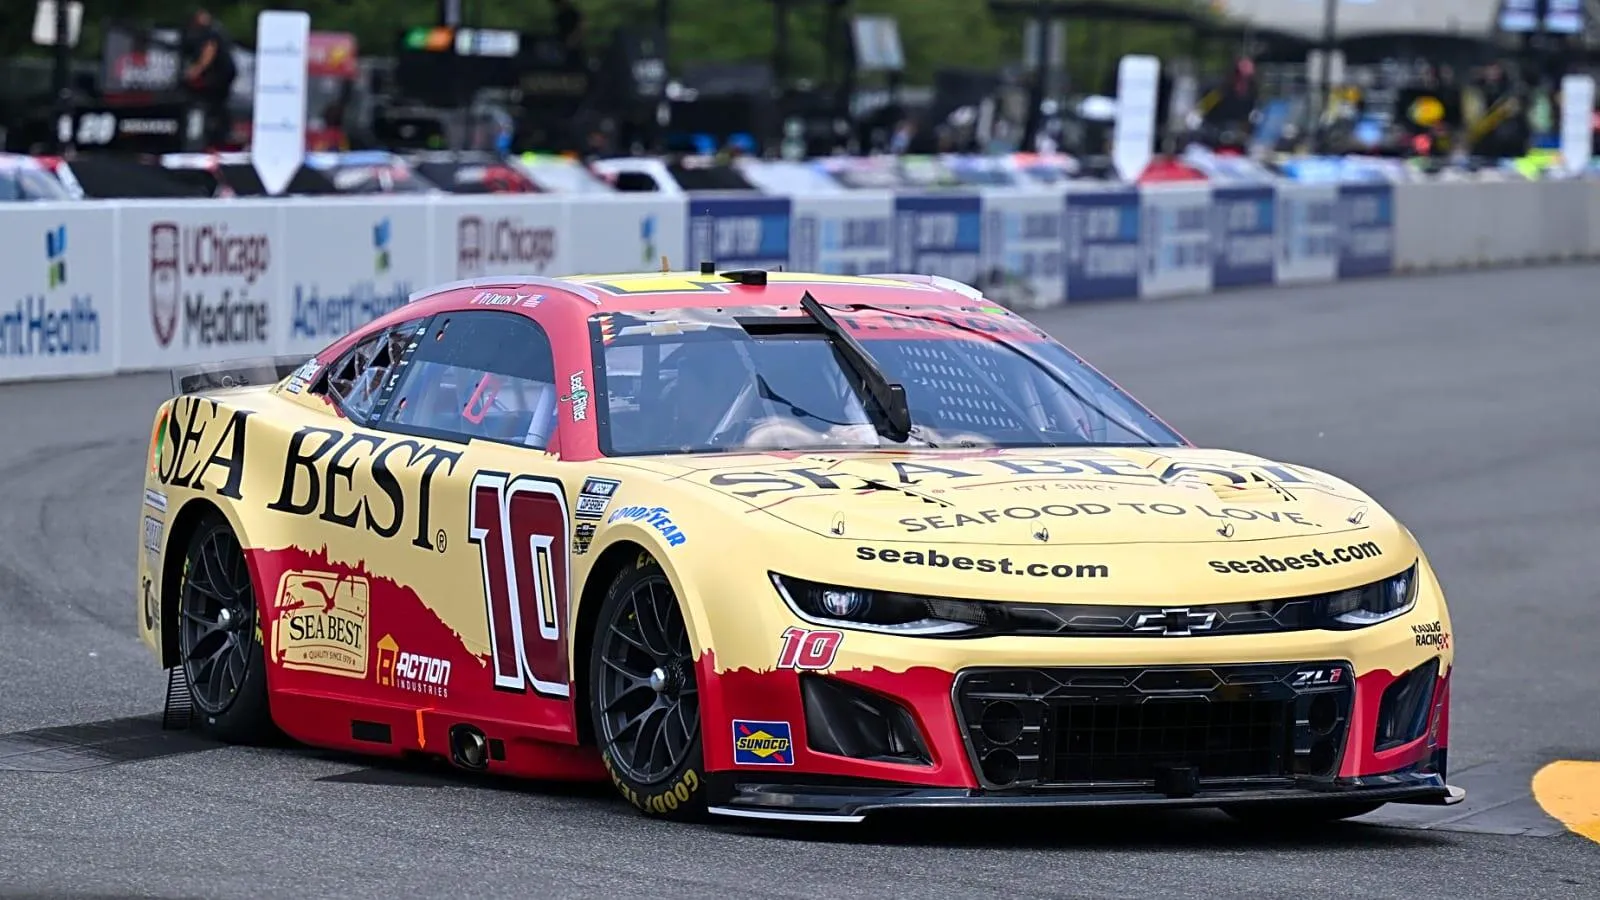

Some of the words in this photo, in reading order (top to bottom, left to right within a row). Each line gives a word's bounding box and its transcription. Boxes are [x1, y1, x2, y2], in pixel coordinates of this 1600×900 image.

[184, 223, 269, 283] UChicago
[0, 295, 100, 355] ntHealth
[184, 291, 269, 346] Medicine
[159, 396, 256, 500] SEA
[267, 425, 464, 550] BEST
[608, 505, 687, 547] GOODYEAR
[897, 502, 1112, 532] SEAFOOD
[1118, 503, 1186, 515] TO
[1195, 504, 1322, 527] LOVE.
[856, 546, 1109, 578] seabest.com
[1208, 539, 1383, 574] seabest.com
[468, 470, 570, 699] 10
[289, 614, 326, 641] SEA
[328, 615, 363, 649] BEST
[1411, 621, 1441, 634] KAULIG
[1415, 633, 1443, 646] RACING
[777, 626, 844, 670] 10
[396, 651, 451, 686] ACTION
[396, 678, 448, 698] INDUSTRIES
[737, 736, 788, 751] SUNOCO
